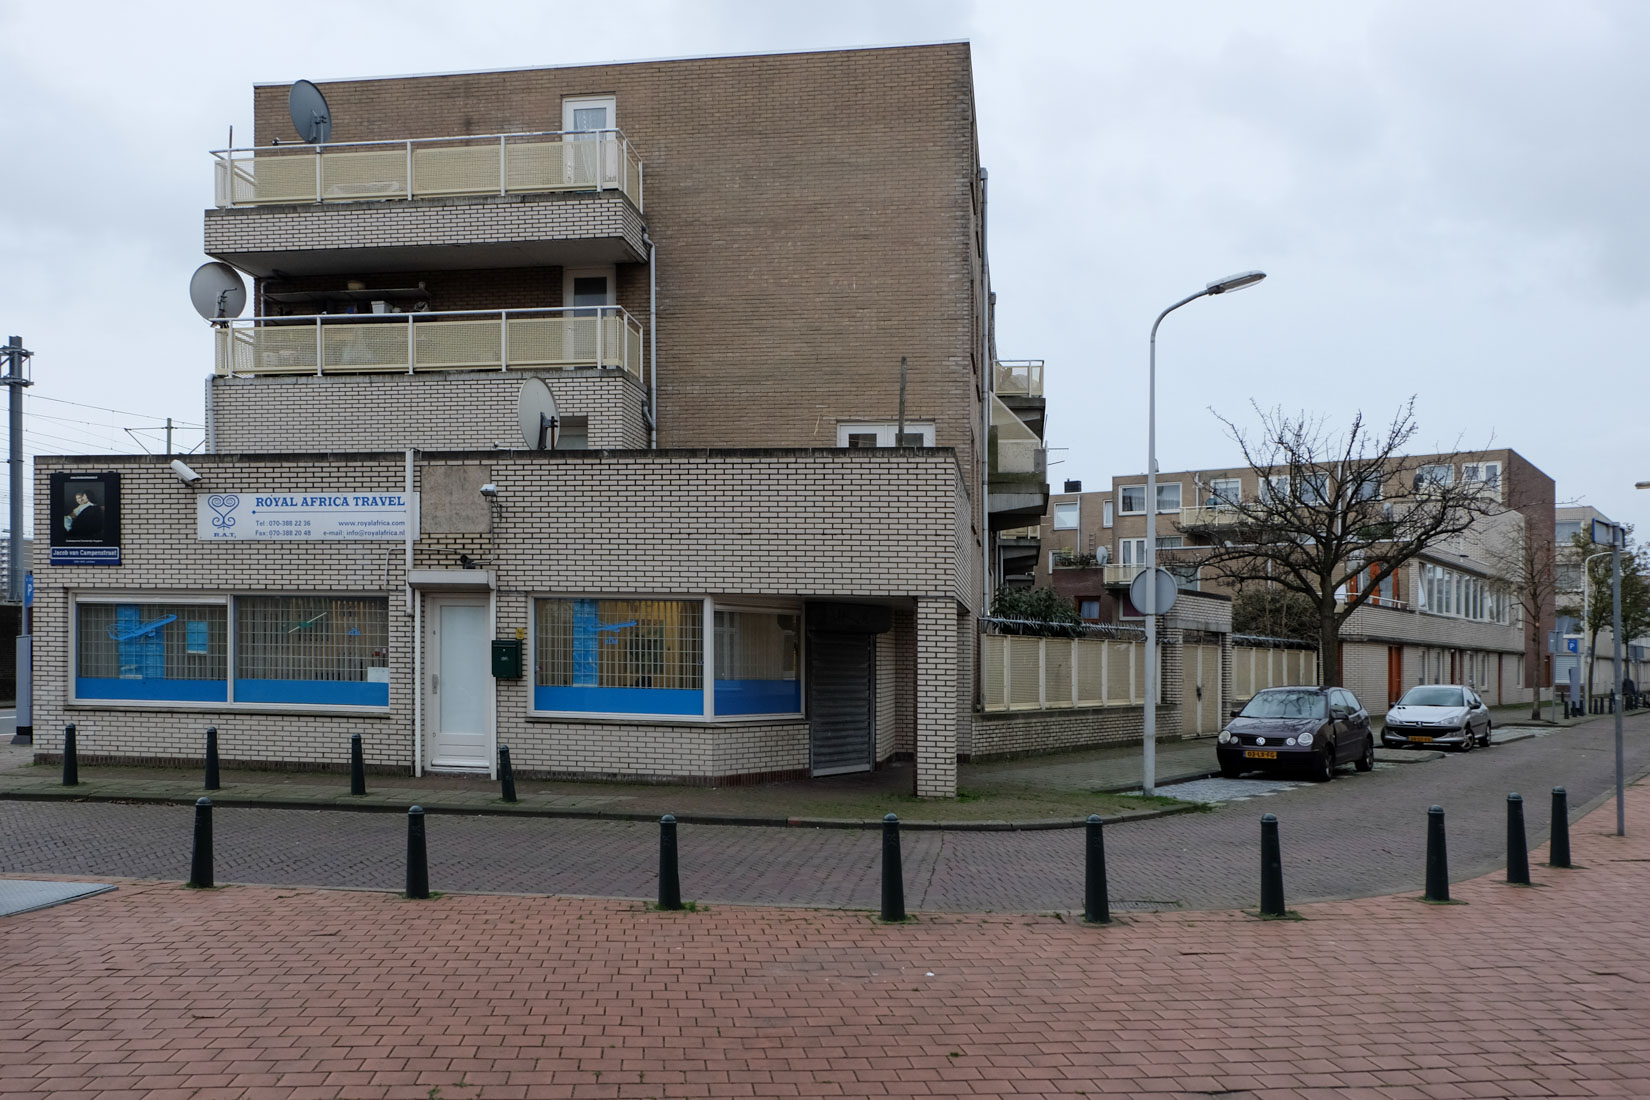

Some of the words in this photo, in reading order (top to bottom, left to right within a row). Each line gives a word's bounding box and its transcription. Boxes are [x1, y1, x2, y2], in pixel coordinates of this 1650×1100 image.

[255, 496, 298, 507] ROYAL
[301, 496, 350, 507] AFRICA
[353, 495, 406, 506] TRAVEL
[346, 529, 406, 537] info@royalafrica.nl
[27, 583, 33, 596] P
[1569, 642, 1575, 650] P
